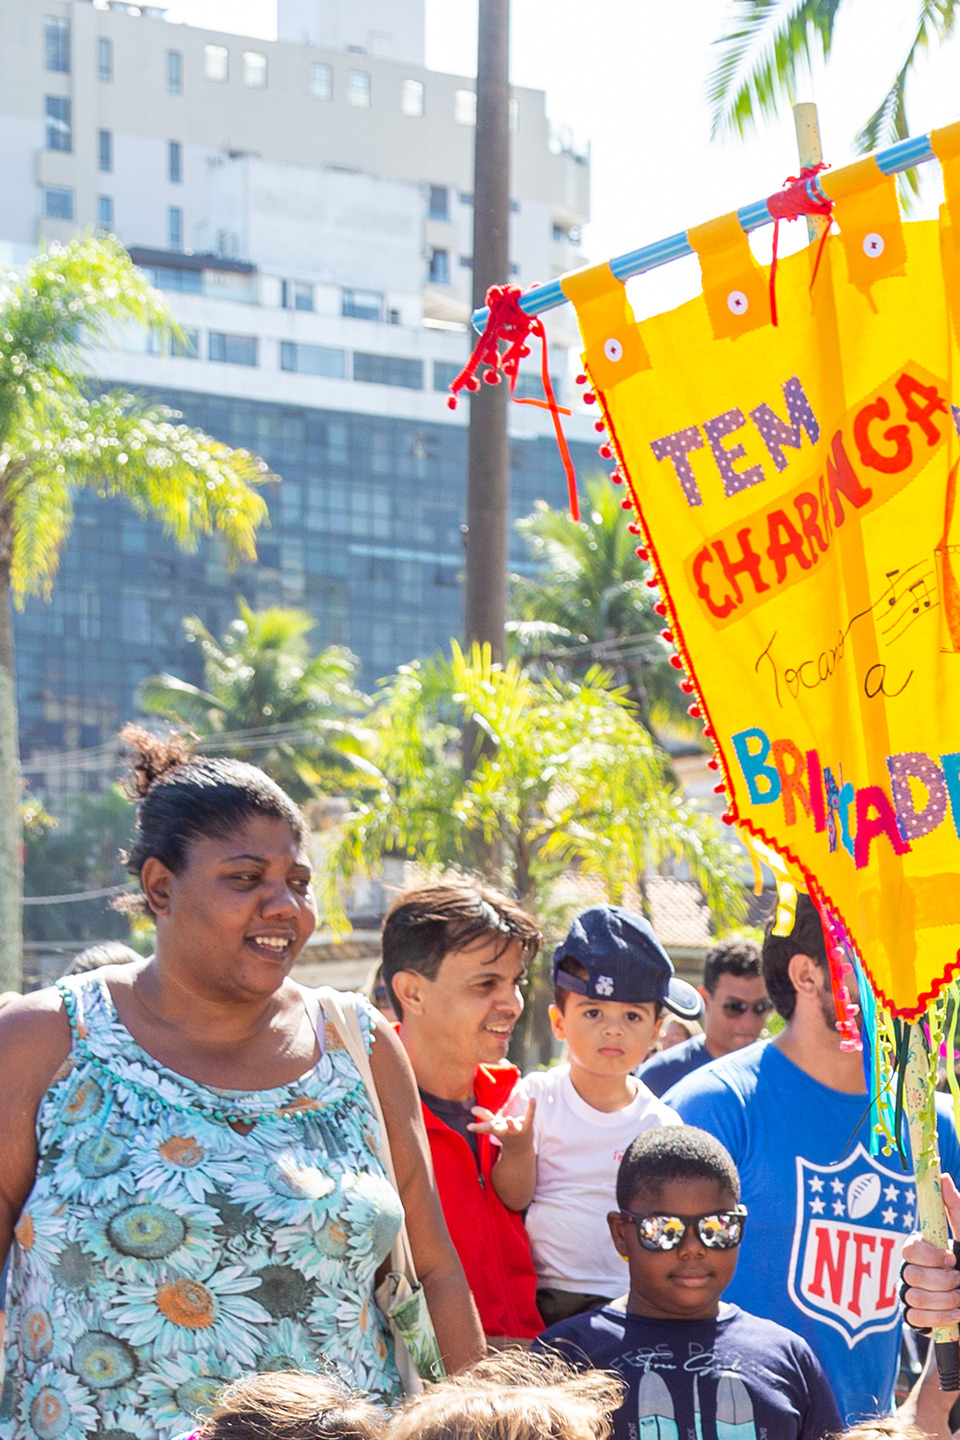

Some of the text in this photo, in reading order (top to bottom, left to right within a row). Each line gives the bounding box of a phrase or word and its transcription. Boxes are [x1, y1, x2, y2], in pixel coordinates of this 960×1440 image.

[649, 375, 820, 507] TEM
[864, 663, 914, 698] a
[807, 1227, 898, 1318] NFL
